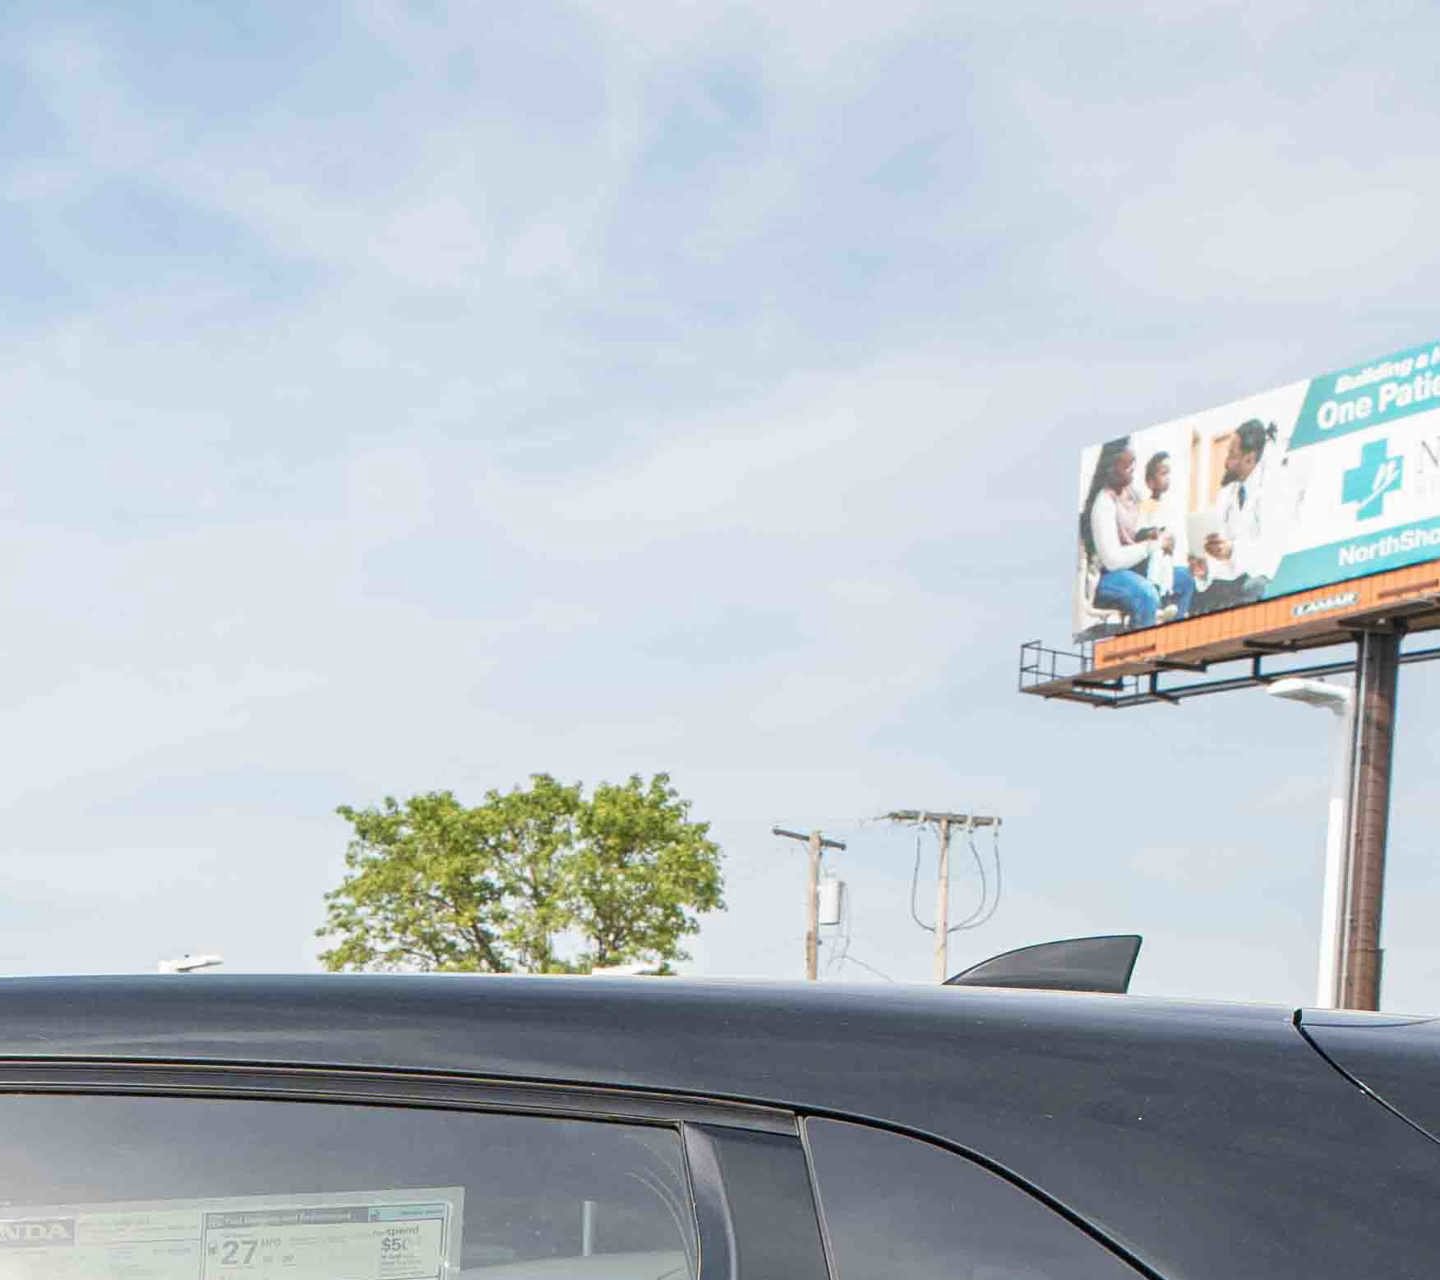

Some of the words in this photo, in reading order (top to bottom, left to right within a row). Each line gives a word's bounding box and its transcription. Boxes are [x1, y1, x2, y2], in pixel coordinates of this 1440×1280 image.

[1334, 359, 1414, 394] Building
[1415, 355, 1429, 369] a
[1316, 396, 1372, 430] One
[220, 1239, 259, 1266] 27
